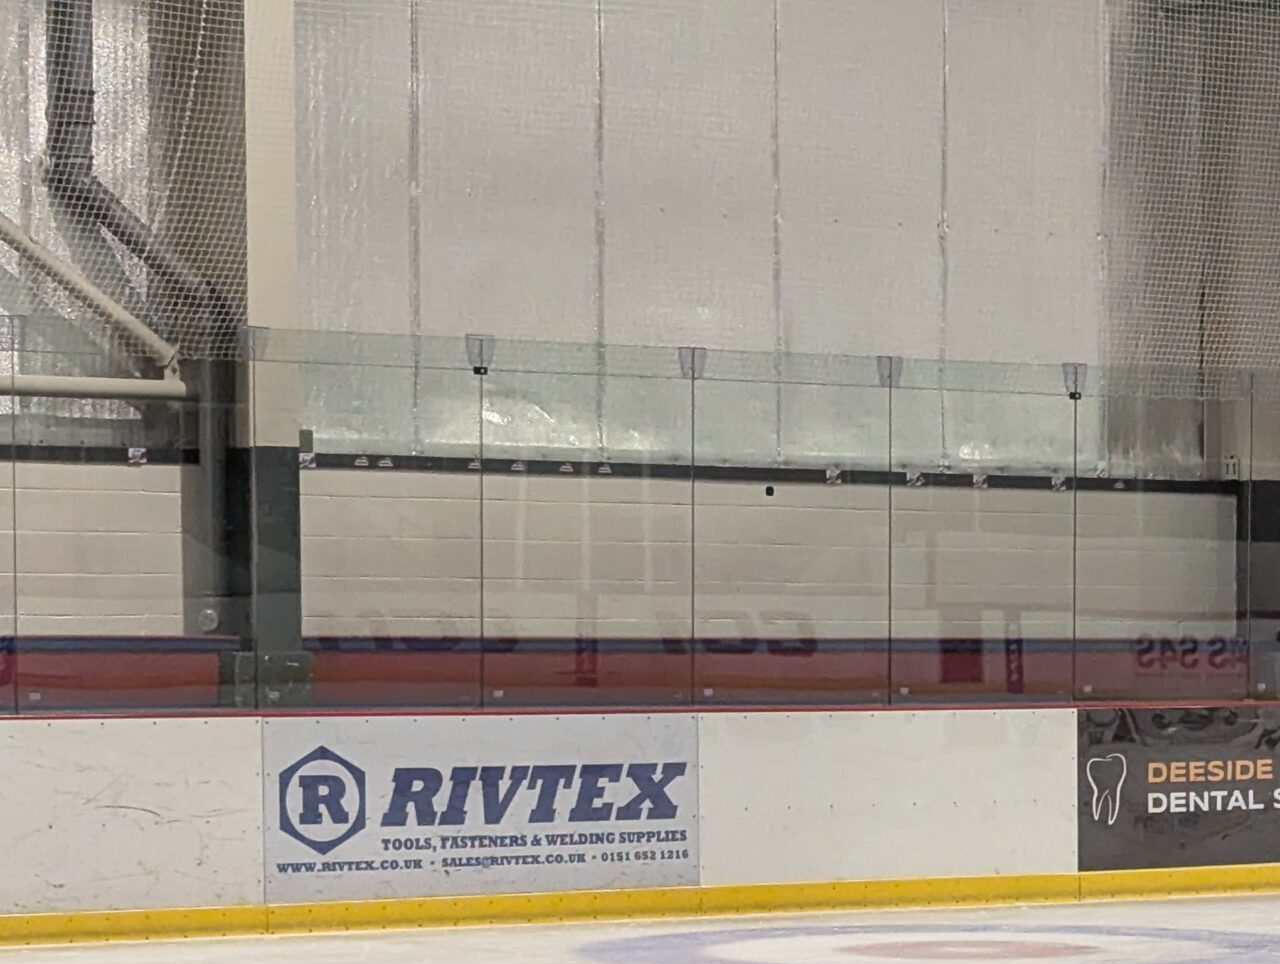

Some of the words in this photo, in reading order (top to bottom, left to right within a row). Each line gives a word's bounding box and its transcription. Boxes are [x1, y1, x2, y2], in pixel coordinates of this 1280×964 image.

[1147, 759, 1273, 784] DEESIDE
[298, 775, 350, 825] R
[380, 762, 688, 827] RIVTEX
[1147, 789, 1264, 814] DENTAL
[381, 837, 438, 852] TOOLS,
[440, 834, 528, 850] FASTENERS
[530, 834, 541, 847] &
[545, 832, 616, 847] WELDING
[618, 830, 688, 844] SUPPLIES
[276, 859, 423, 873] WWW.RIVTEX.CO.UK
[441, 853, 587, 868] SALES@RIVTEX.CO.UK
[601, 851, 630, 862] 0151
[634, 850, 657, 862] 652
[660, 849, 689, 860] 1216
